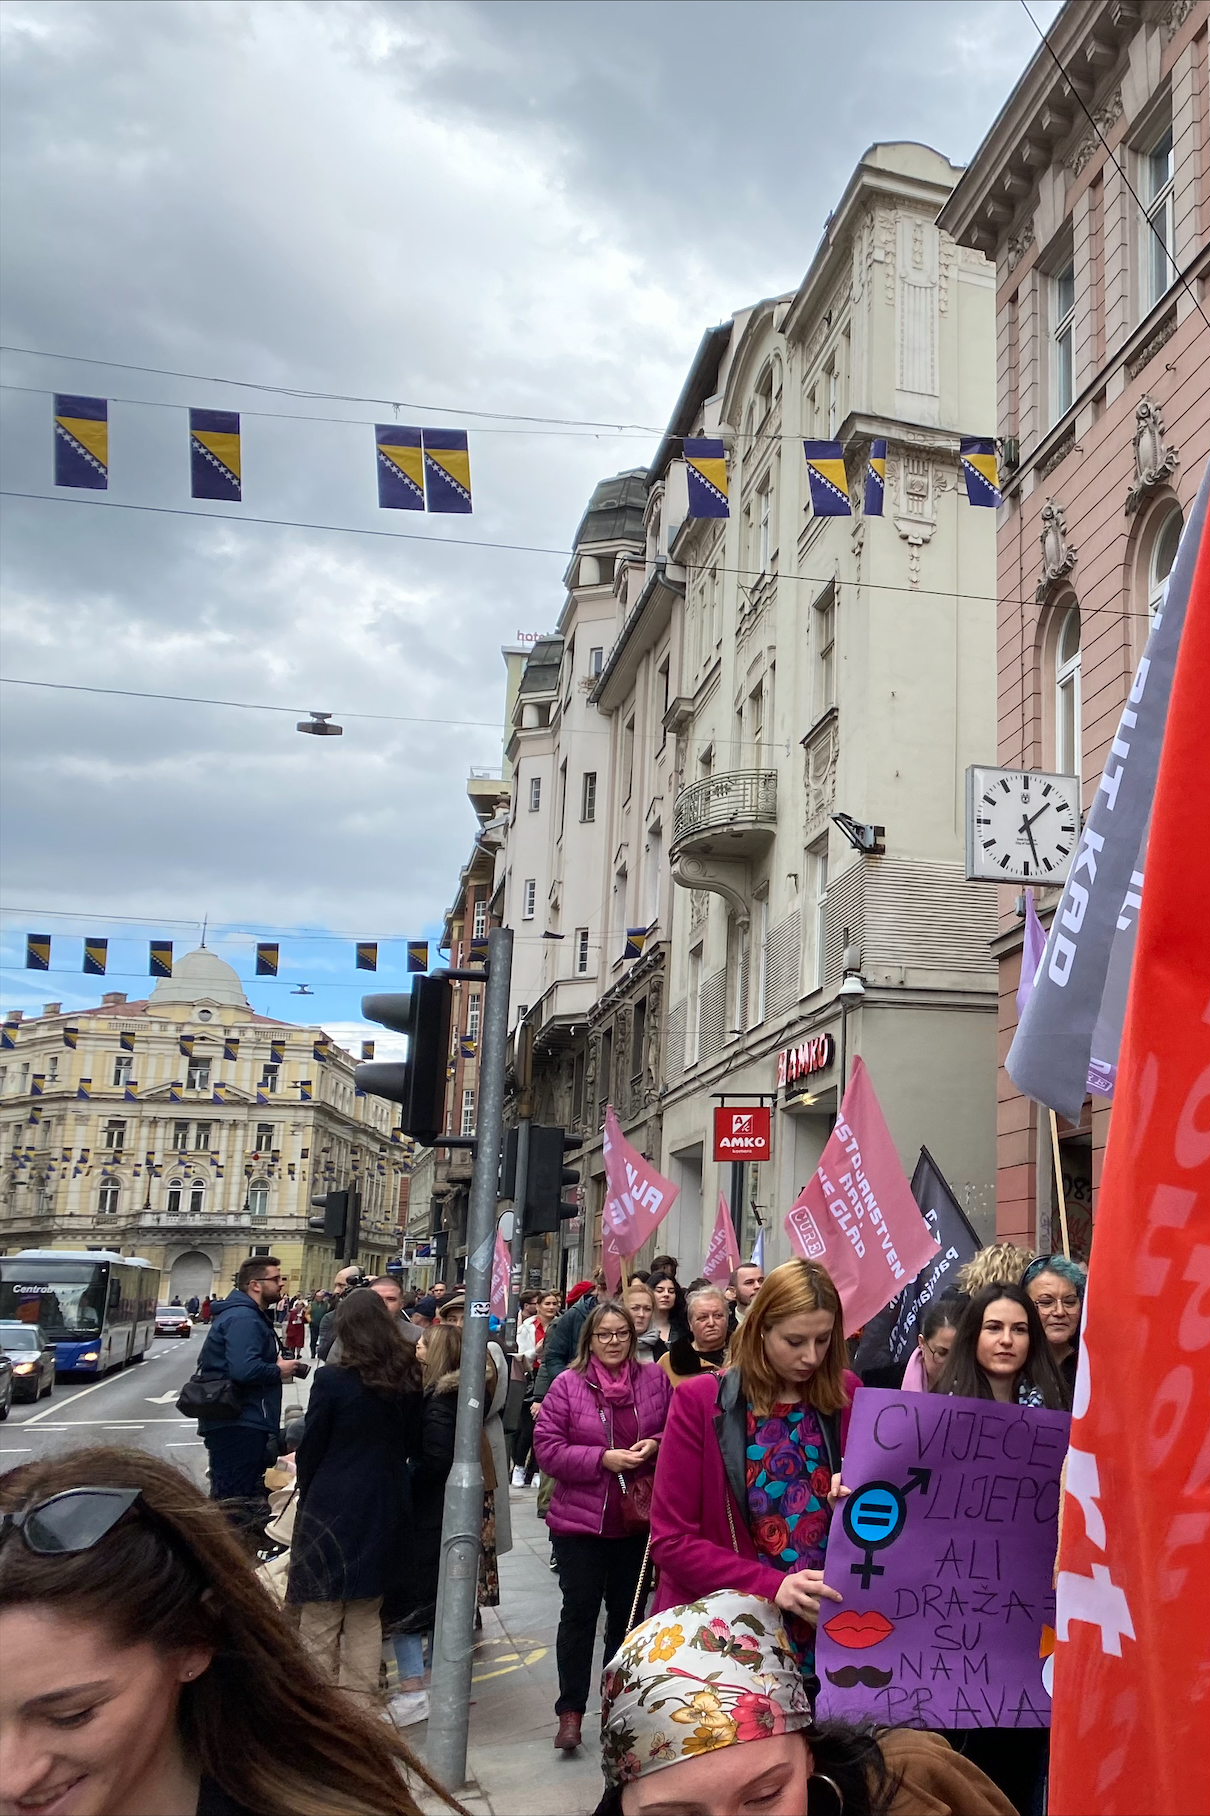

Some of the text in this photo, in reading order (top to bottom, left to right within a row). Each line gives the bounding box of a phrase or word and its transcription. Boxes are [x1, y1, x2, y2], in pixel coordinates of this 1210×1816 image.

[719, 1137, 766, 1148] AMKO
[794, 1210, 823, 1254] CURE
[829, 1198, 866, 1259] GLAD
[923, 1473, 1061, 1524] LIJEPO
[934, 1538, 1002, 1581] ALI
[889, 1583, 1035, 1625] DRAŽA
[930, 1622, 982, 1651] SU
[899, 1651, 990, 1684] NAM
[874, 1685, 1051, 1729] PRAVA
